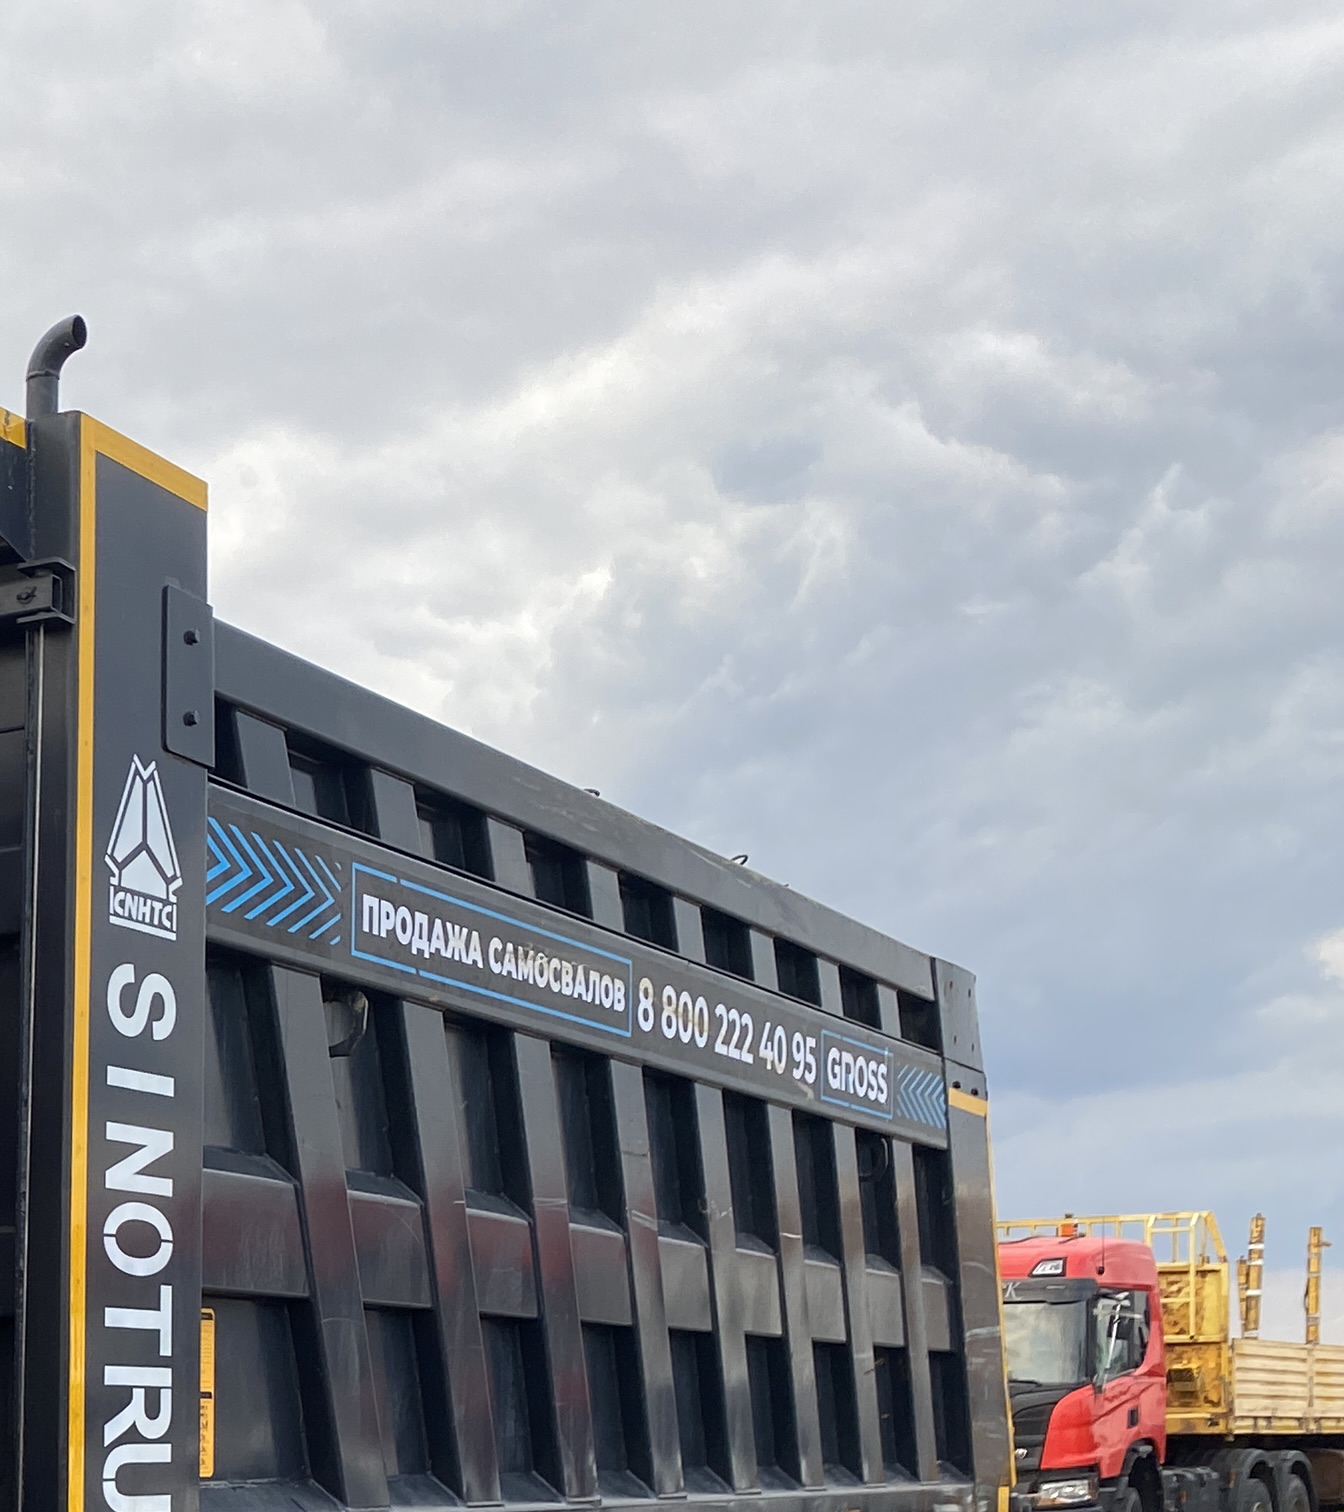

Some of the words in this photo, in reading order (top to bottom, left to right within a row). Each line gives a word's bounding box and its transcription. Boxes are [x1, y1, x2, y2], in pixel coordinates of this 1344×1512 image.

[114, 891, 172, 929] CNHTC
[362, 893, 484, 969] ПРОДАЖА
[488, 937, 626, 1012] САМОСВАЛОВ
[637, 977, 654, 1032] 8
[661, 985, 709, 1048] 800
[714, 1003, 753, 1064] 222
[759, 1021, 787, 1075] 40
[792, 1032, 816, 1084] 95
[827, 1047, 888, 1104] GROSS
